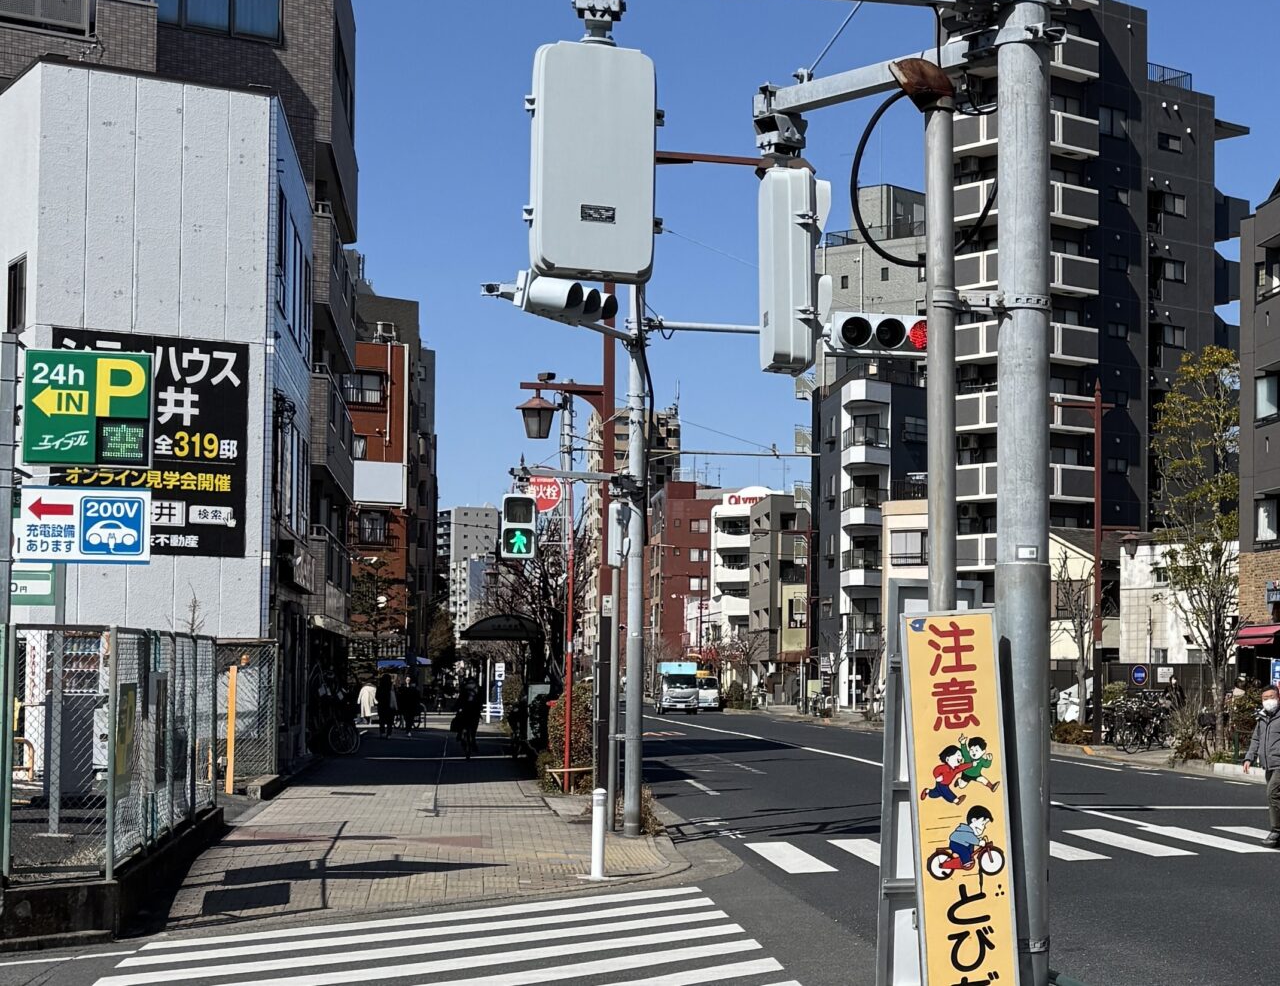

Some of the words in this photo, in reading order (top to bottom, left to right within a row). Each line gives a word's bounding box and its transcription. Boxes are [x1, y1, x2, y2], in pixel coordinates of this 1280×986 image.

[32, 362, 85, 385] 24h
[95, 357, 146, 418] P
[57, 391, 84, 412] IN
[32, 429, 90, 451] エイブル
[154, 431, 238, 460] 全319邸
[65, 467, 232, 492] オンライン見学会開催
[85, 501, 139, 518] 200V
[151, 502, 177, 523] 井
[198, 508, 222, 521] 検索
[26, 523, 76, 538] 充電設備
[26, 539, 75, 553] あります
[927, 620, 981, 732] 注意
